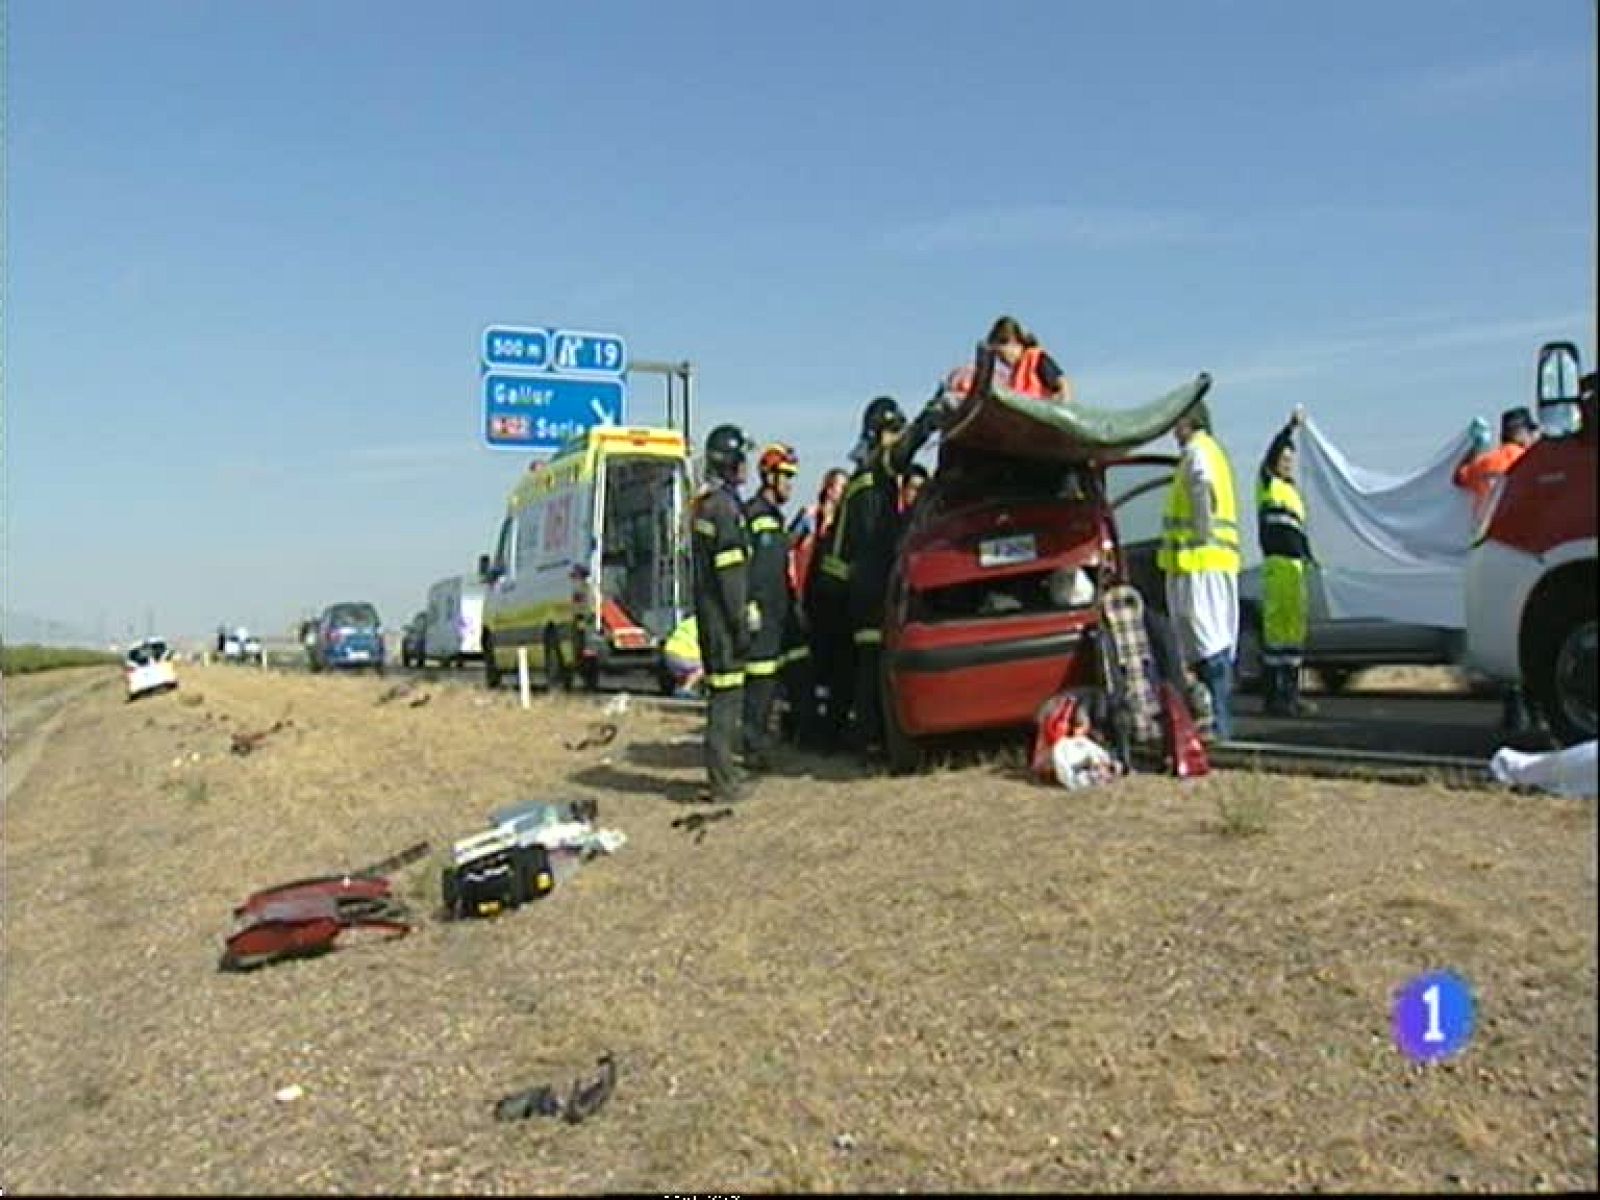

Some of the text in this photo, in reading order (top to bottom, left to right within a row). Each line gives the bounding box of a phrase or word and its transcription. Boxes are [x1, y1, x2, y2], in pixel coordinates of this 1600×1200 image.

[527, 343, 543, 357] m
[595, 342, 618, 367] 19
[494, 382, 554, 405] Gallur
